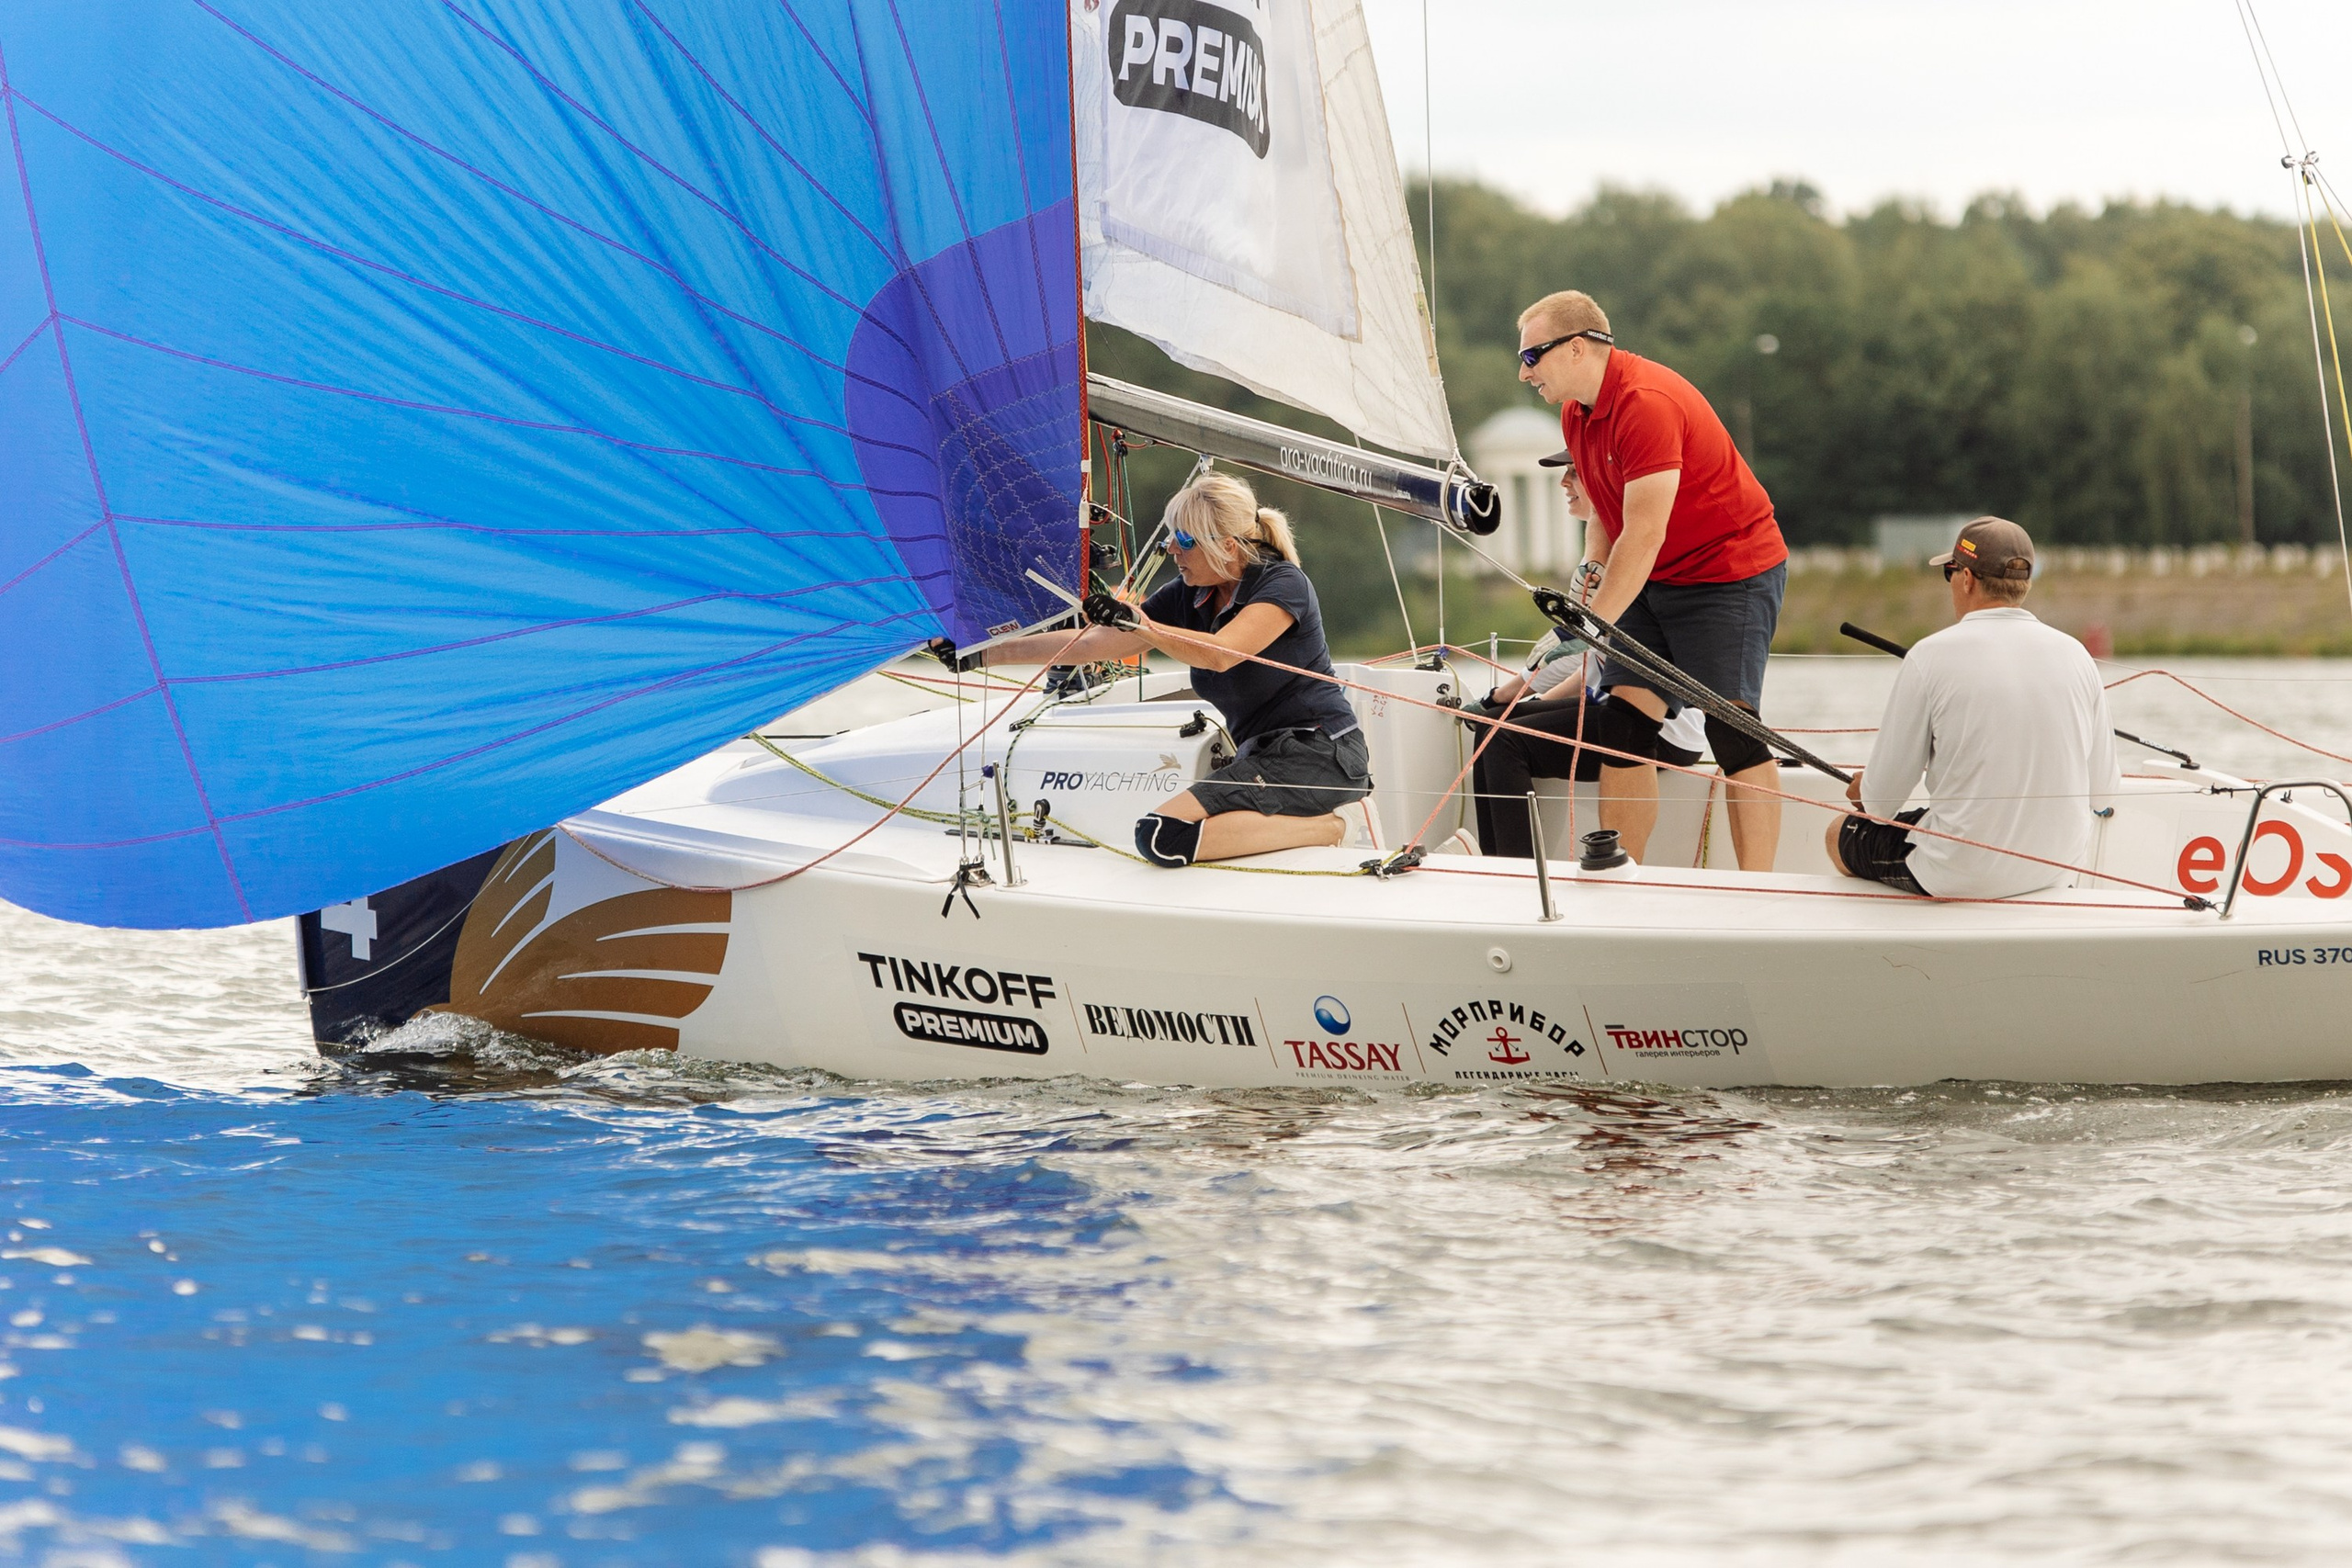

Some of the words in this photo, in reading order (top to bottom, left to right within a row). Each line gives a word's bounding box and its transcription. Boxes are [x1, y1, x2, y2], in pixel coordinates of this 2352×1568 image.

[1280, 446, 1373, 492] pro-yachting.ru
[2258, 949, 2306, 965] RUS
[857, 952, 1057, 1009] TINKOFF
[900, 1009, 1041, 1049] PREMIUM
[1082, 1003, 1258, 1046] ВЕДОМОСТИ
[1430, 999, 1586, 1057] МОРПРИБОР
[1283, 1040, 1402, 1071] TASSAY
[1670, 1049, 1721, 1058] интерьеров
